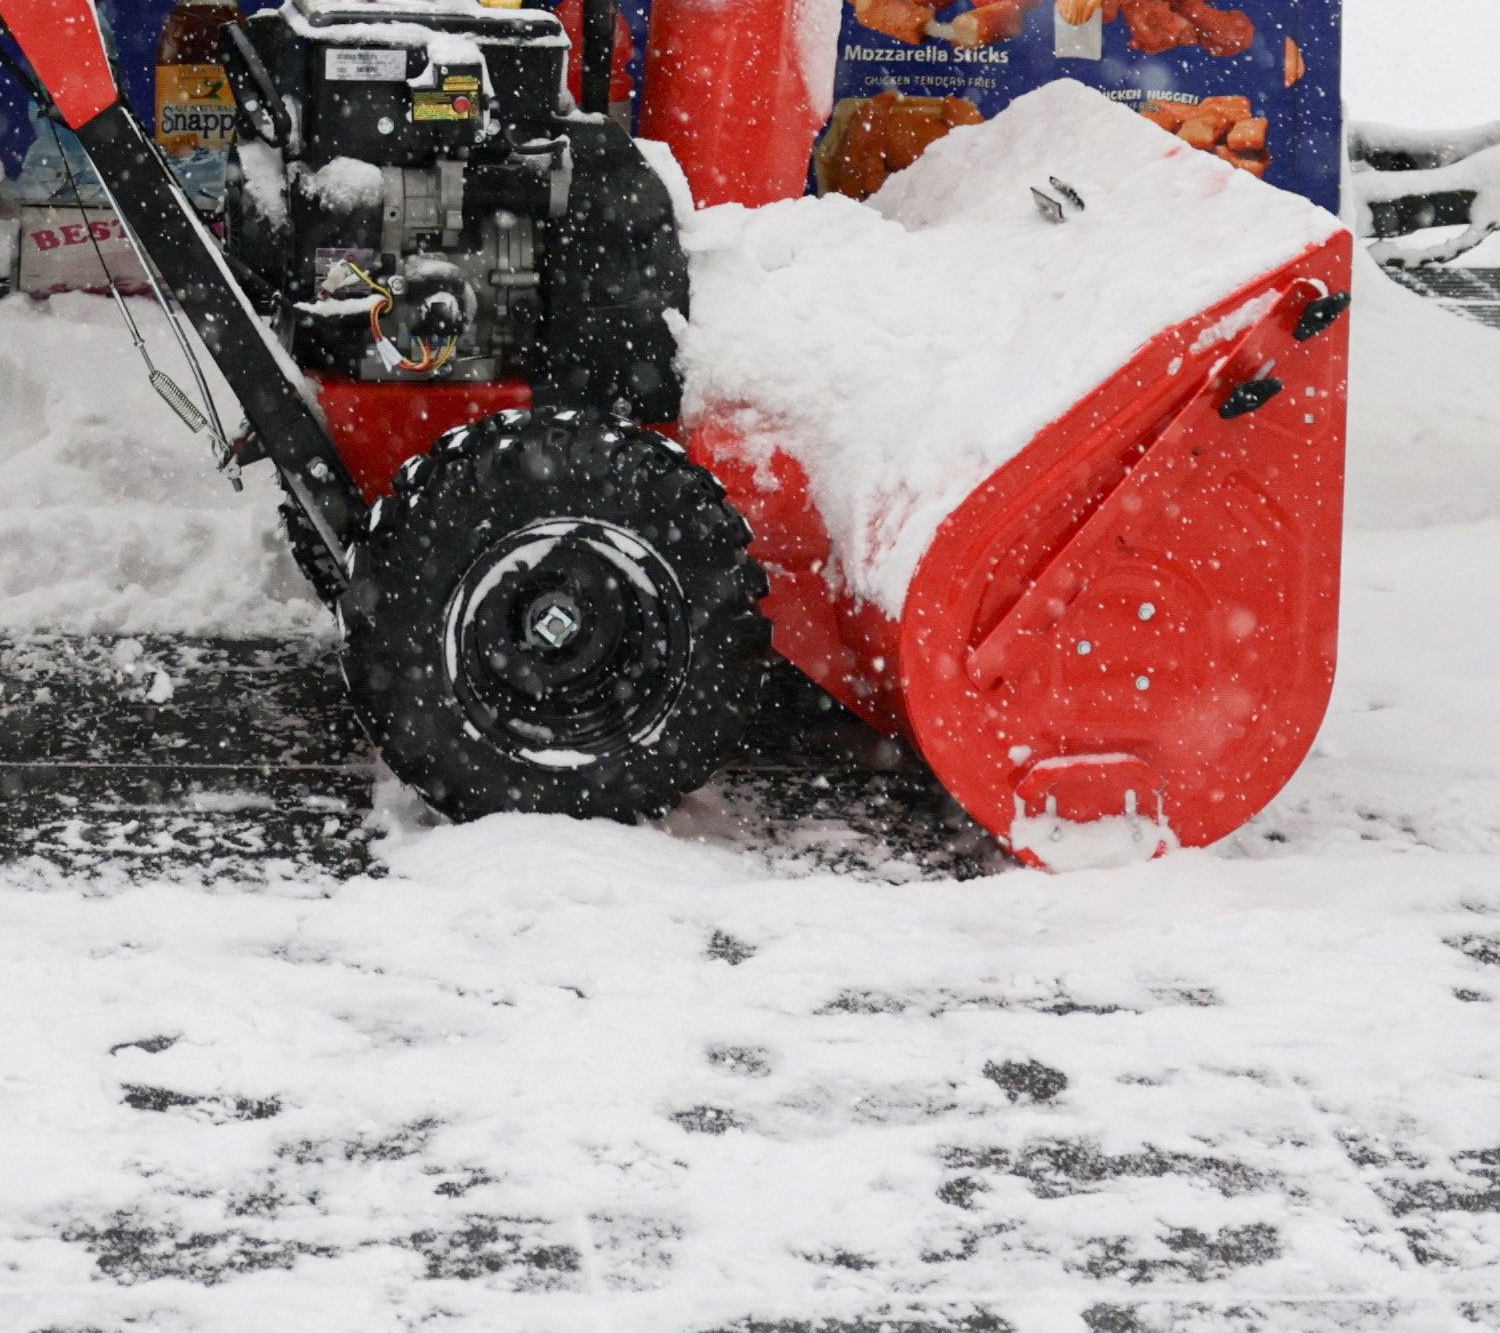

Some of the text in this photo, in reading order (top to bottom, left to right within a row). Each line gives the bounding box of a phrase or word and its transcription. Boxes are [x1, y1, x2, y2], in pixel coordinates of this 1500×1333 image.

[843, 44, 1010, 64] Mozzarella Sticks
[863, 75, 912, 87] CHICKEN
[161, 105, 237, 140] Snapp
